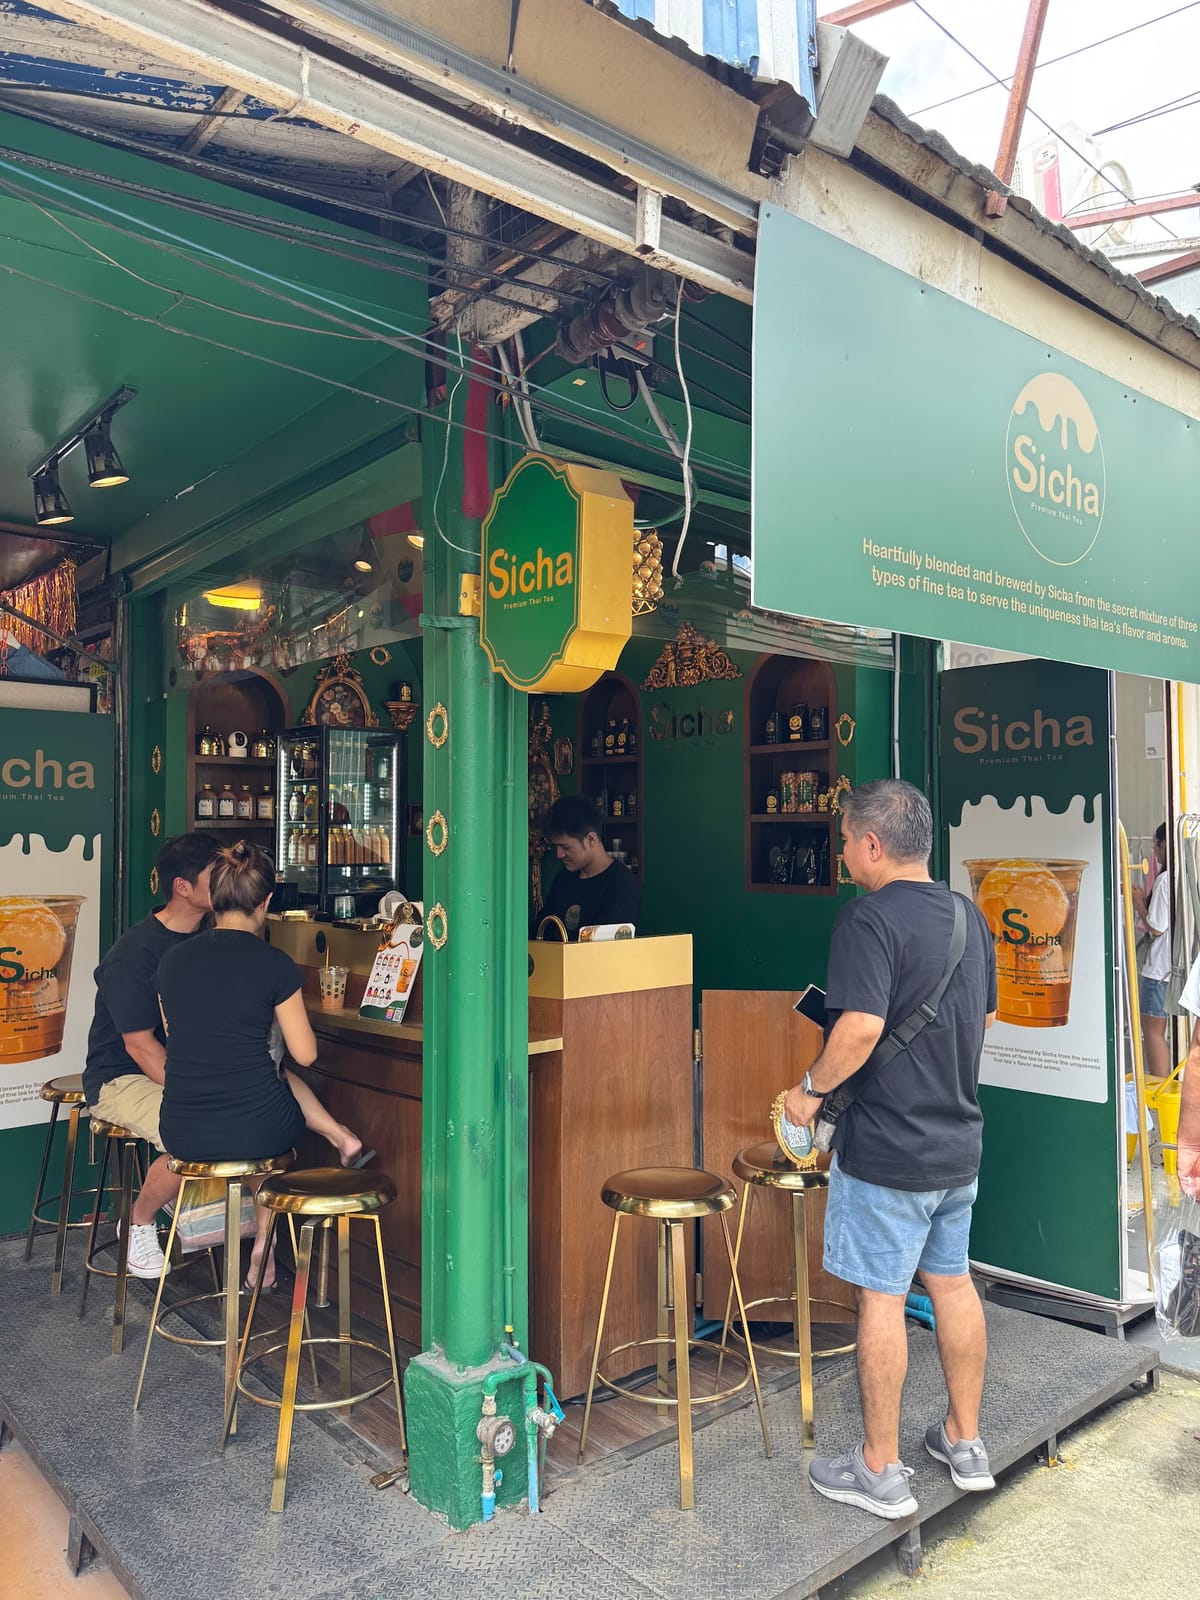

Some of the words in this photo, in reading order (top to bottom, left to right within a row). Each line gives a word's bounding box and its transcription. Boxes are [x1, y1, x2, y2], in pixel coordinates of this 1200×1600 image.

[1013, 434, 1099, 517] Sicha
[1031, 502, 1056, 517] Premium
[1059, 511, 1071, 521] Thai
[1073, 515, 1083, 526] Tea
[488, 547, 573, 600] Sicha
[863, 538, 922, 570] Heartfully
[925, 554, 970, 579] blended
[973, 569, 992, 584] and
[995, 571, 1032, 593] brewed
[1035, 580, 1046, 599] by
[1048, 584, 1073, 603] Sicha
[1075, 592, 1095, 609] from
[1097, 597, 1110, 612] the
[1112, 604, 1138, 619] secret
[1139, 609, 1167, 626] mixture
[1168, 616, 1178, 628] of
[1178, 617, 1198, 633] three
[503, 601, 527, 610] Premium
[529, 598, 542, 606] Thai
[543, 595, 554, 603] Tea
[872, 565, 905, 587] types
[908, 575, 920, 590] of
[923, 577, 944, 595] fine
[947, 583, 964, 600] tea
[967, 587, 977, 603] to
[980, 593, 1009, 609] serve
[1011, 597, 1027, 613] the
[1029, 603, 1081, 625] uniqueness
[1083, 613, 1099, 630] thai
[1100, 618, 1121, 634] tea's
[1122, 622, 1145, 640] flavor
[1147, 631, 1161, 643] and
[1162, 633, 1189, 649] aroma.
[953, 707, 1094, 754] Sicha
[1, 749, 95, 790] cha
[979, 756, 1019, 765] Premium
[1022, 754, 1043, 762] Thai
[1047, 752, 1063, 761] Tea
[21, 793, 43, 801] Thai
[47, 793, 65, 801] Tea
[1002, 908, 1062, 946] Sicha
[0, 946, 57, 984] Sicha
